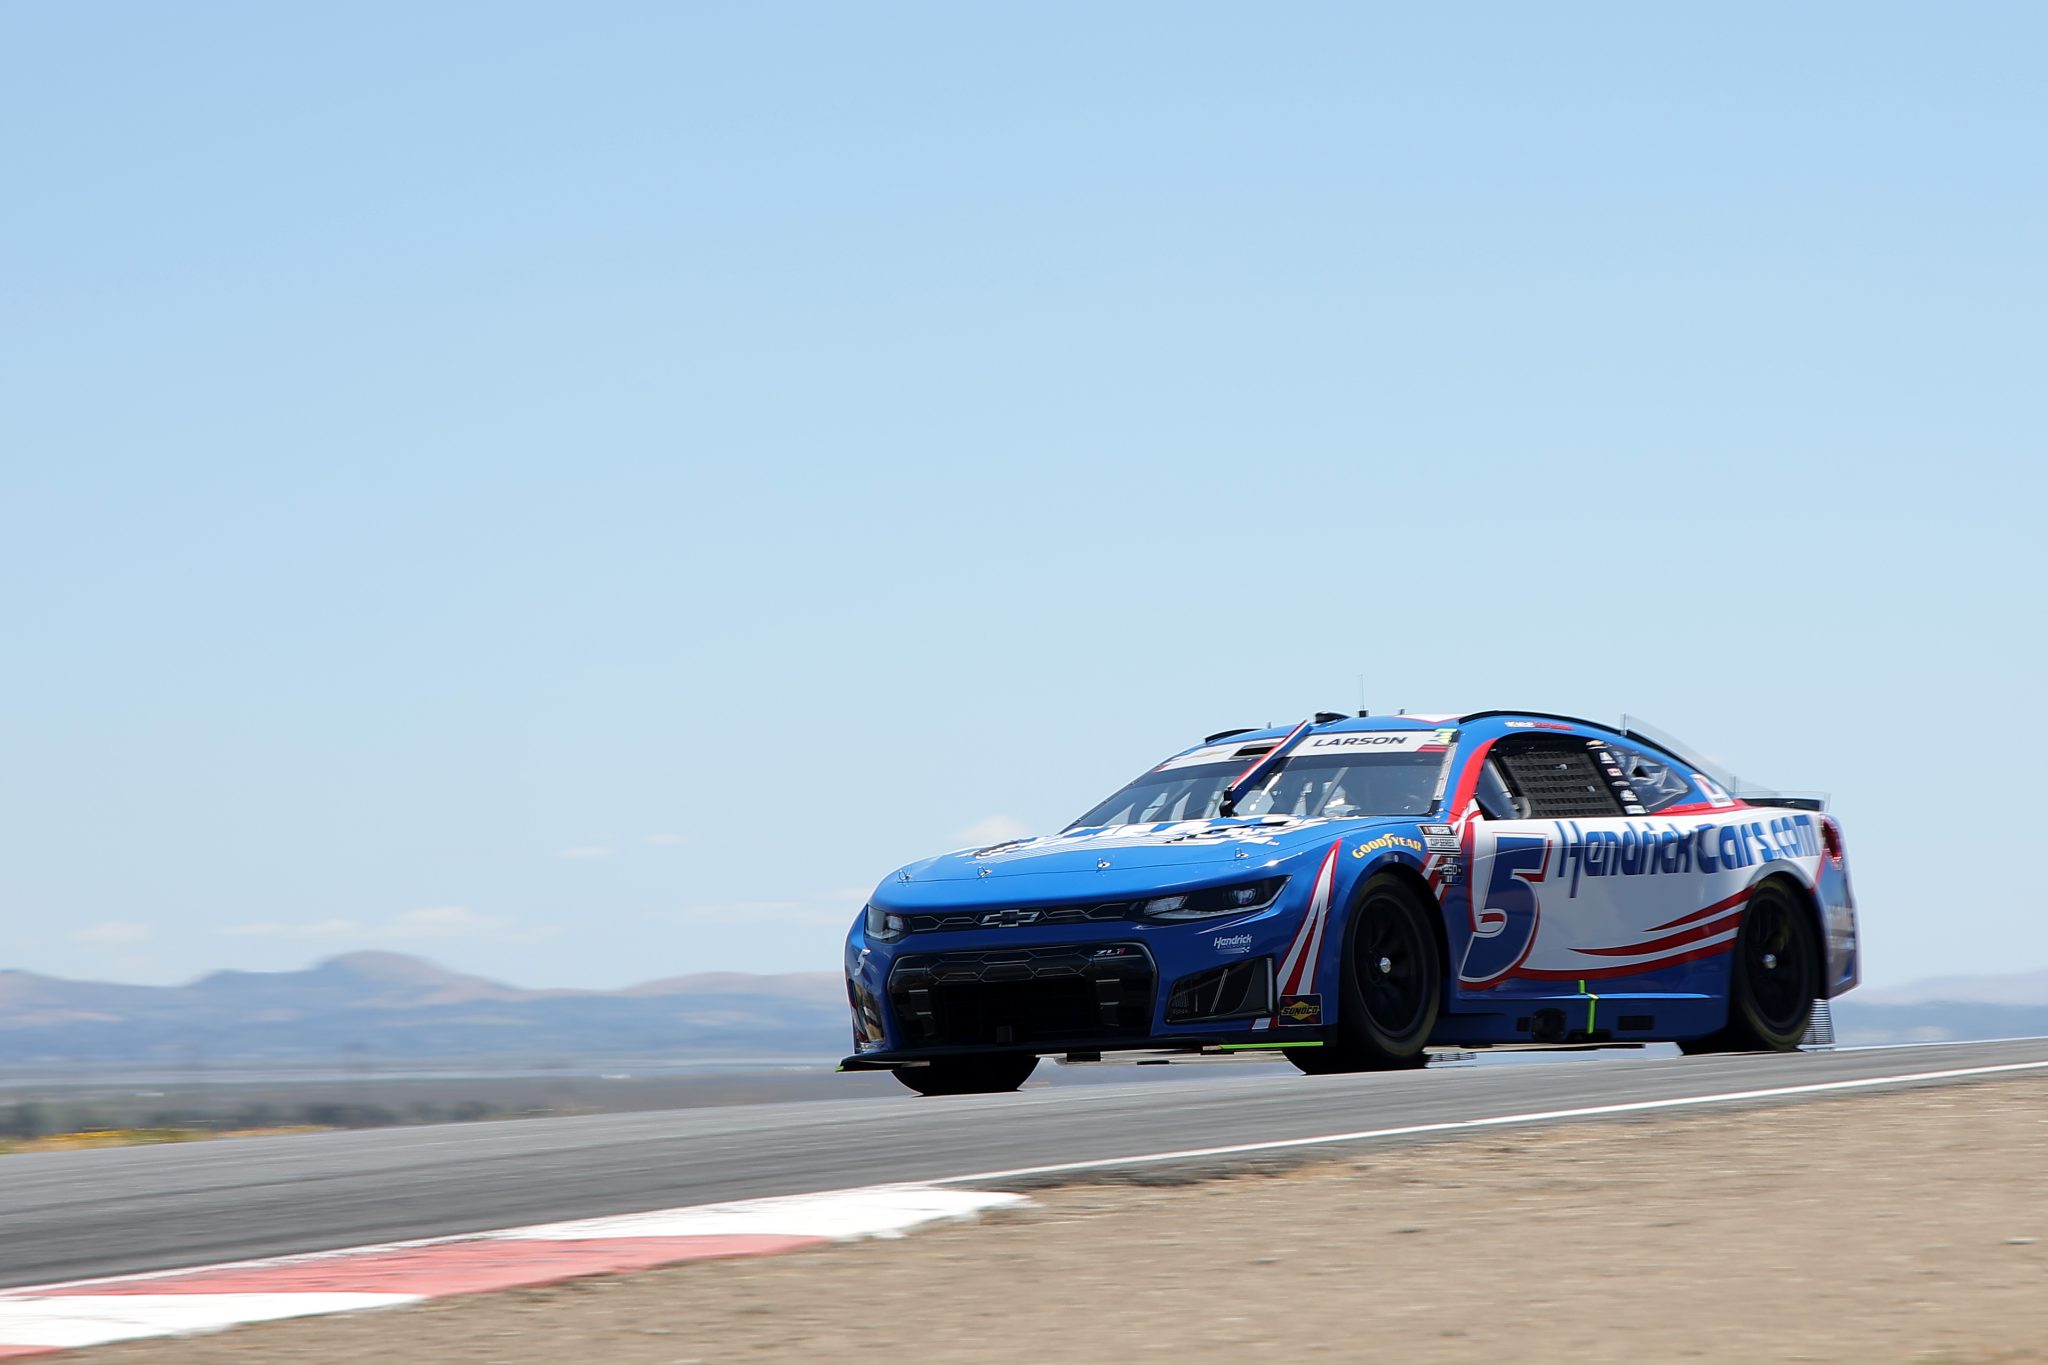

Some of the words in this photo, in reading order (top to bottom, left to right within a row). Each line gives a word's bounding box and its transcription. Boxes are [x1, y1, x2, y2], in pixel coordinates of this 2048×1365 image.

[1313, 736, 1407, 747] LARSON
[1351, 833, 1422, 859] GOODYEAR
[1554, 814, 1821, 898] HendrickCars.com
[1459, 834, 1552, 986] 5
[1213, 933, 1253, 949] Hendrick
[1281, 1006, 1319, 1016] SUNOCO
